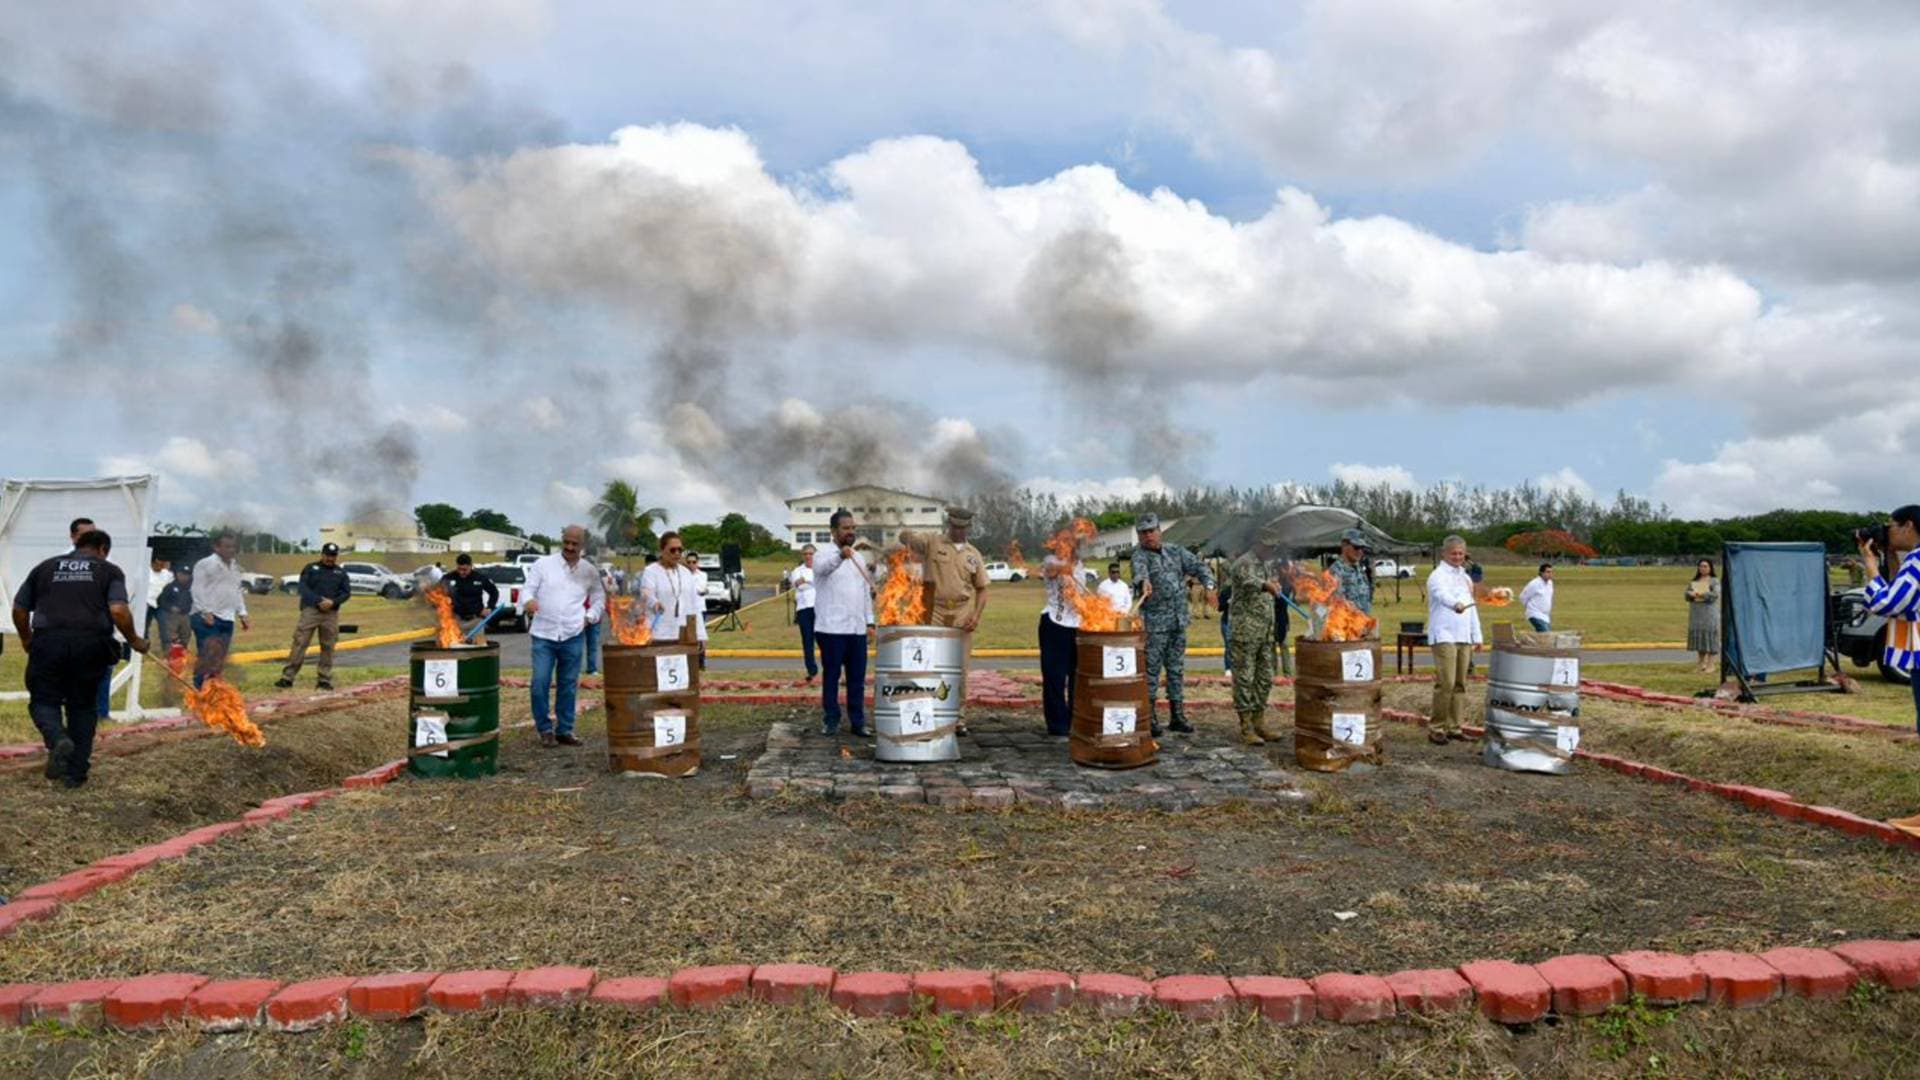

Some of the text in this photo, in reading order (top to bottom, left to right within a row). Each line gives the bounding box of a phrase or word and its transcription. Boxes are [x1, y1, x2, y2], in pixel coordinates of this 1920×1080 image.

[59, 560, 90, 571] FGR
[912, 649, 922, 663] 4
[1115, 655, 1125, 671] 3
[668, 669, 678, 684] 5
[1355, 663, 1363, 678] 2
[1563, 670, 1569, 684] 1
[435, 673, 446, 688] 6
[912, 711, 922, 726] 4
[666, 728, 675, 743] 5
[1115, 721, 1124, 735] 3
[1344, 727, 1353, 743] 2
[426, 730, 436, 746] 6
[1568, 738, 1575, 752] 1
